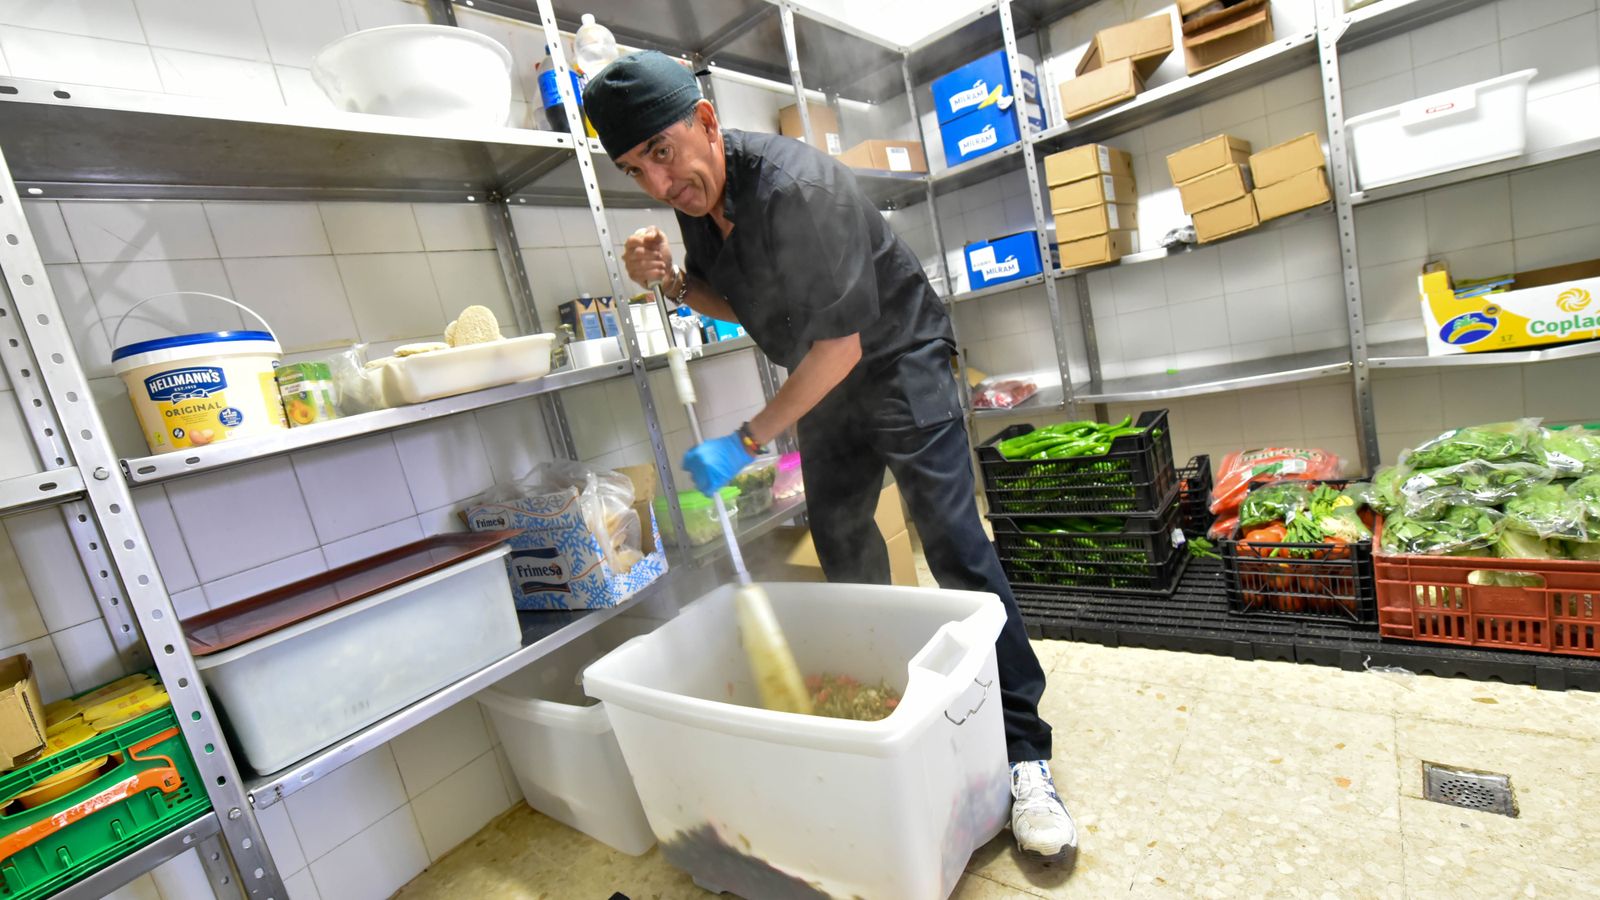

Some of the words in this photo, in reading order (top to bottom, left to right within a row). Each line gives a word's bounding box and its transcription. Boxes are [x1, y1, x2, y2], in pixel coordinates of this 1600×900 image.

[954, 89, 984, 105] MILRAM
[963, 134, 992, 149] MILRAM
[986, 264, 1015, 276] MILRAM
[149, 369, 220, 393] HELLMANN'S
[165, 401, 222, 417] ORIGINAL
[475, 517, 505, 528] Frimesa
[515, 563, 563, 578] Frimesa
